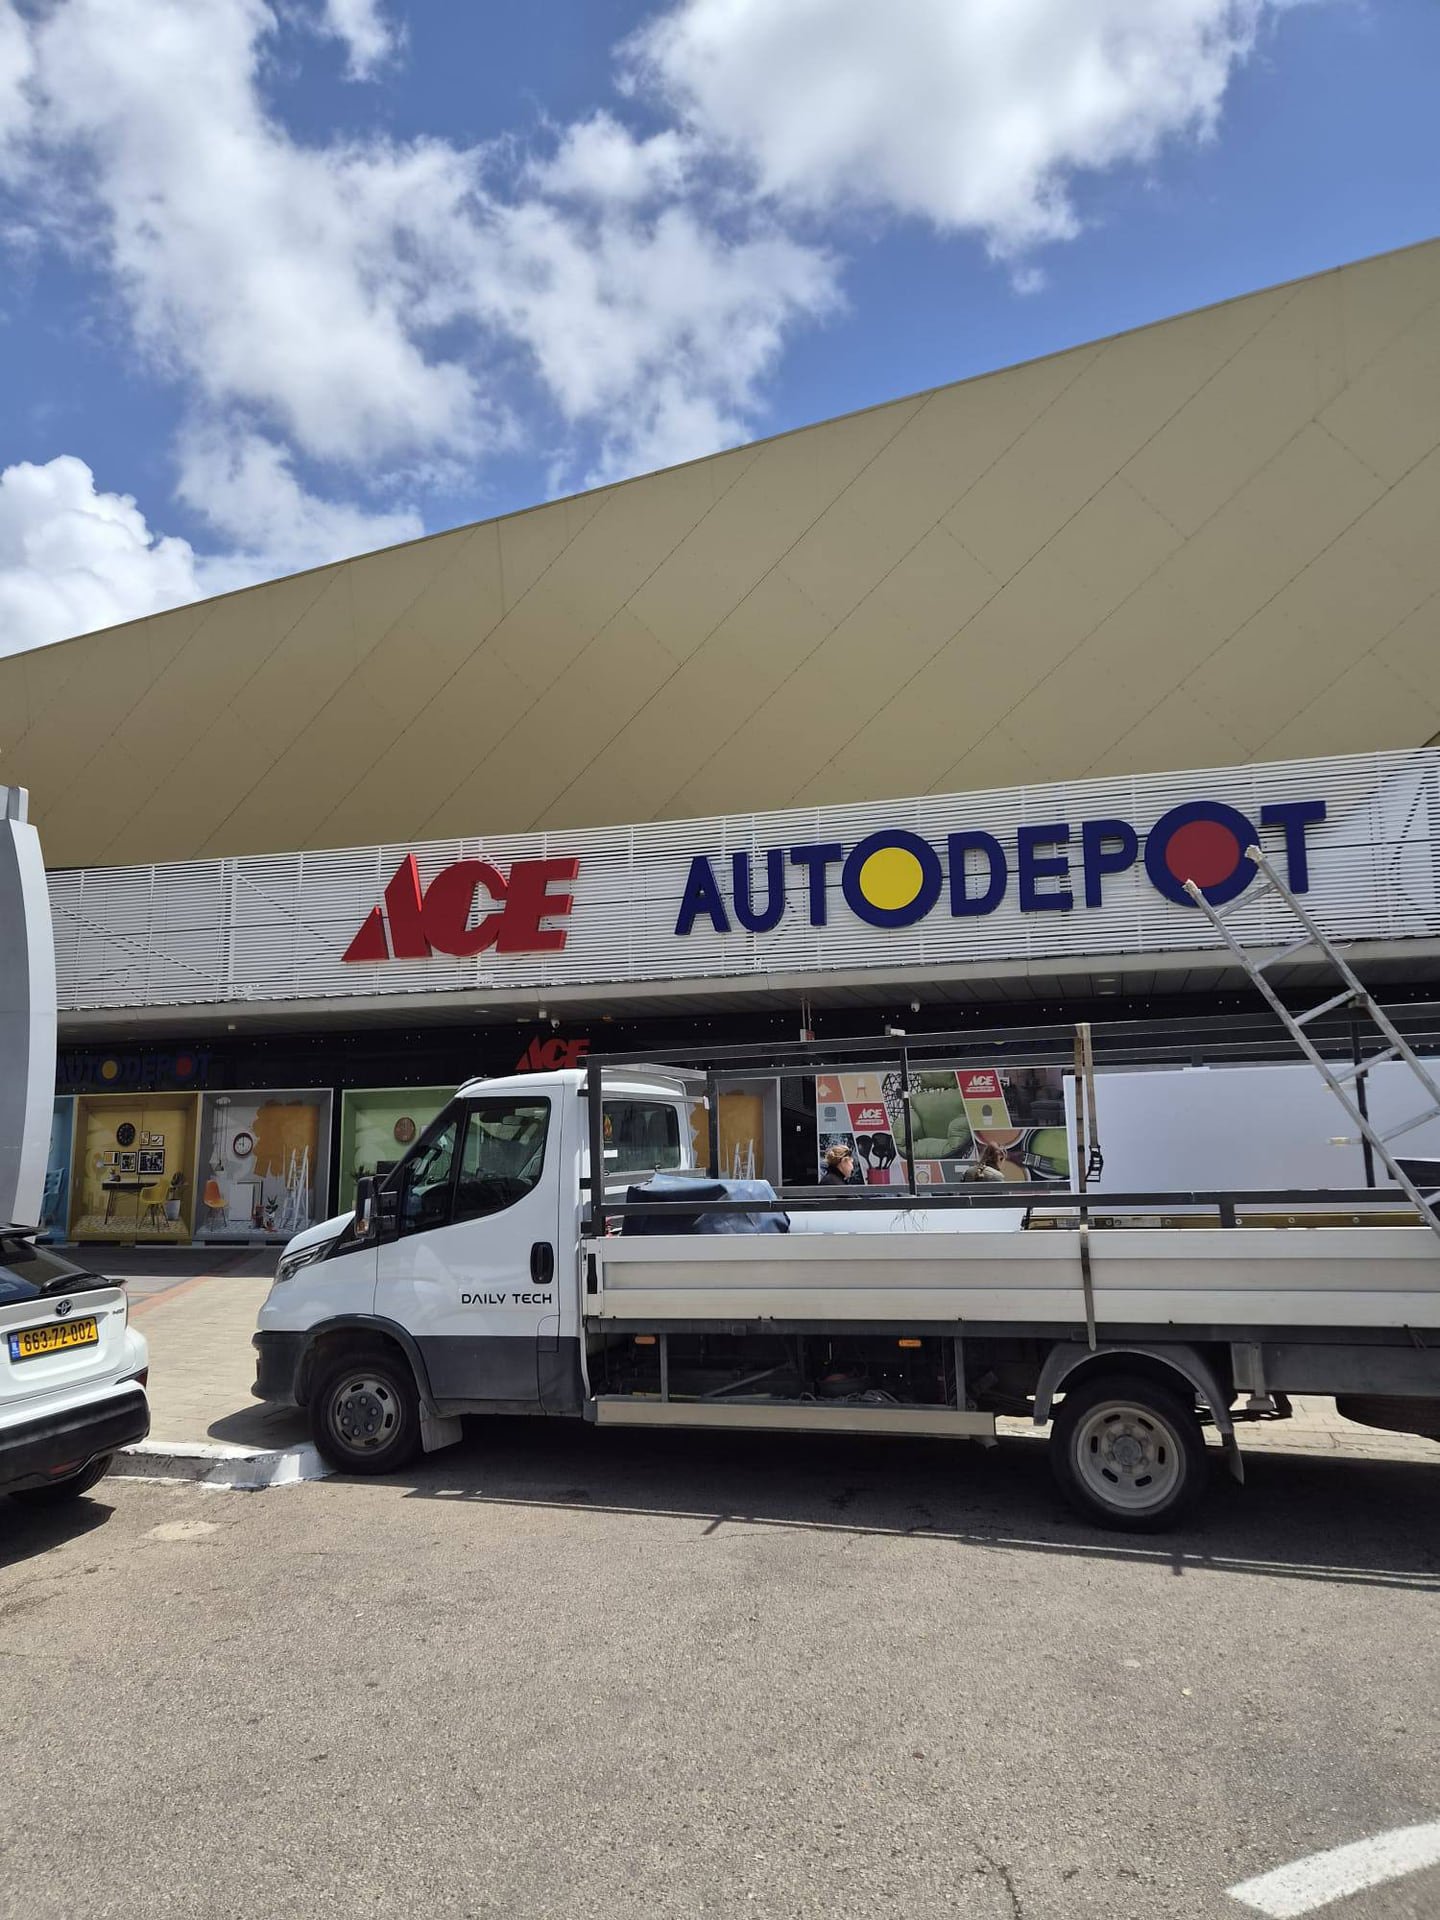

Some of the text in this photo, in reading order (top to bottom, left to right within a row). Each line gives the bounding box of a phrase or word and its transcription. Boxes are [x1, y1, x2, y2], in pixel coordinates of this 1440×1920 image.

[674, 800, 1326, 936] AUTODEPOT
[341, 852, 580, 963] ACE
[515, 1035, 591, 1071] ACE
[968, 1075, 994, 1087] ACE
[858, 1108, 883, 1119] ACE
[461, 1293, 552, 1304] DAILY TECH
